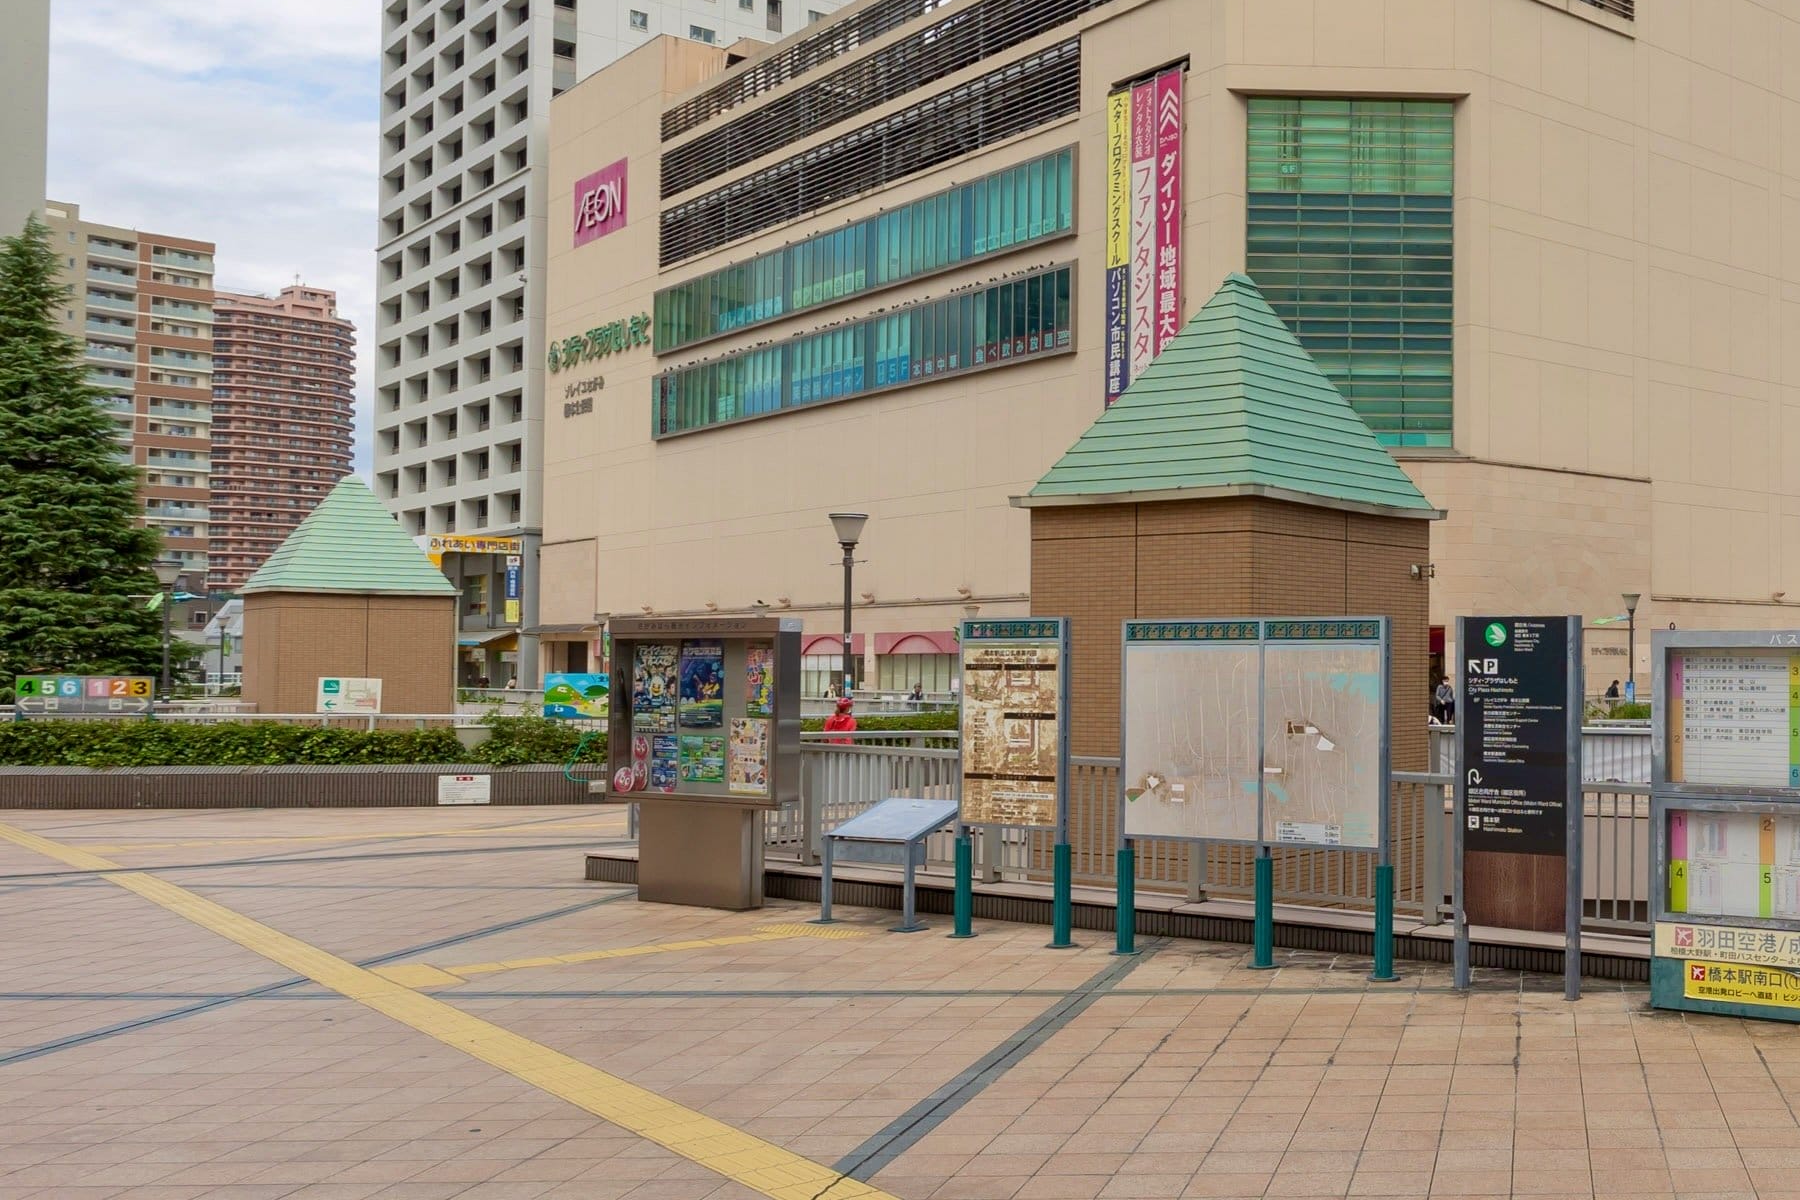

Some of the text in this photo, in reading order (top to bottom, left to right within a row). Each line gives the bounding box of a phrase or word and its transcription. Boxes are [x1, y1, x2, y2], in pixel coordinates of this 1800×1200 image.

[1134, 167, 1151, 362] ファンタジスタ
[1109, 267, 1122, 394] パソコン市民講座
[975, 332, 1054, 363] 食べ飲み放題
[20, 678, 77, 694] 4 5 6
[94, 679, 147, 695] 1 2 3
